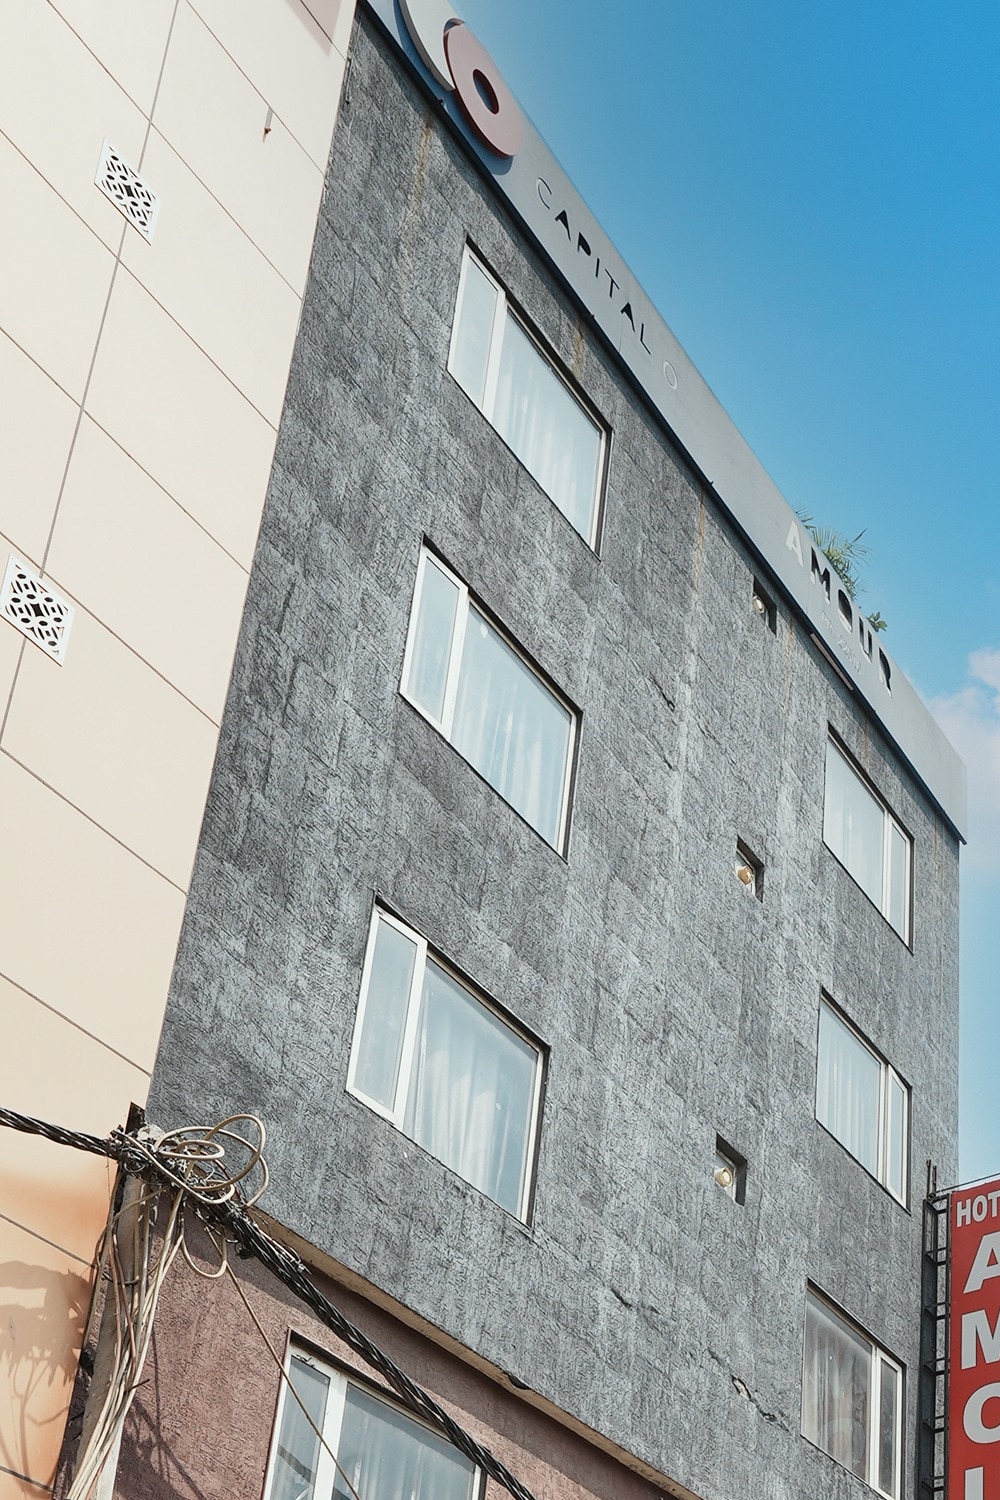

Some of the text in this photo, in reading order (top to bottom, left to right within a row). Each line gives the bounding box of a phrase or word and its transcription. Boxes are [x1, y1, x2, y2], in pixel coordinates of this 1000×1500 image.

[535, 177, 678, 391] CAPITAL O
[785, 520, 892, 698] AMOUR
